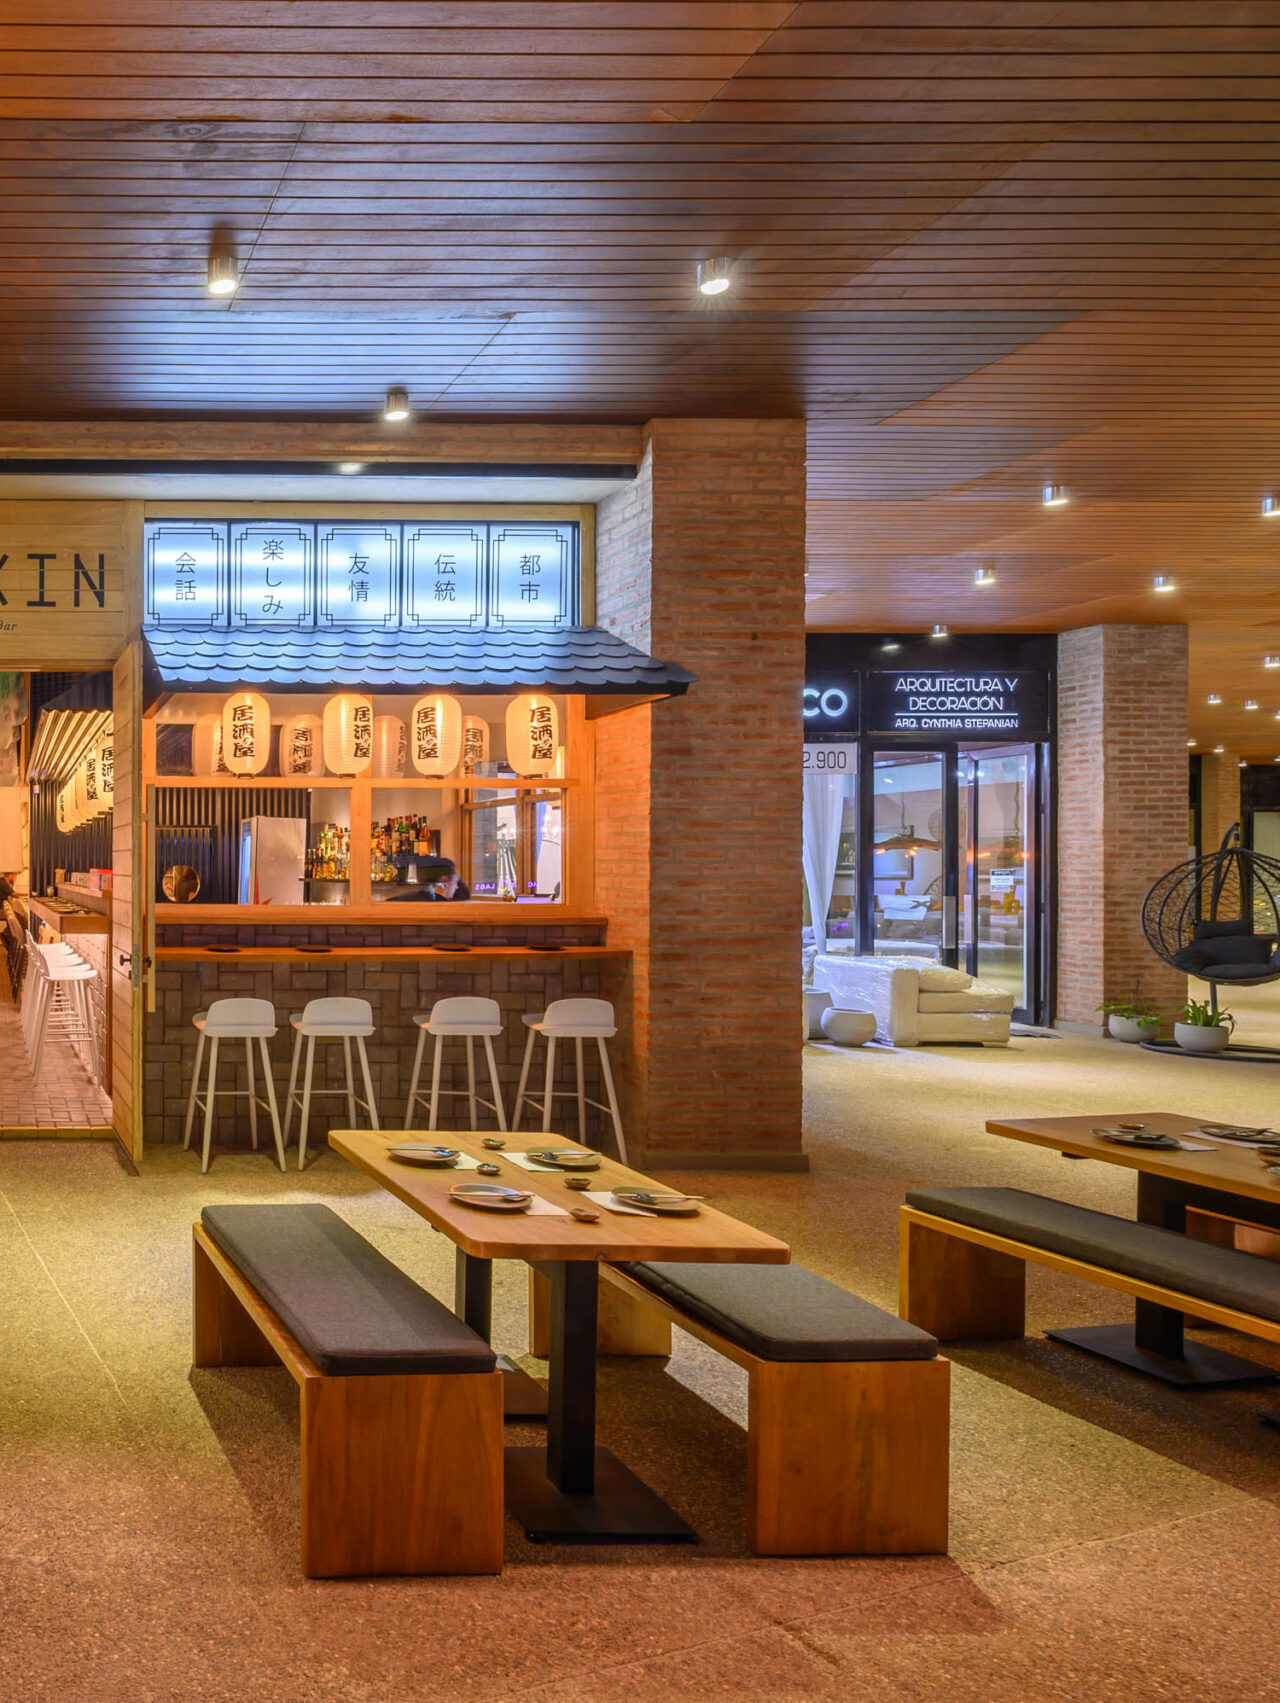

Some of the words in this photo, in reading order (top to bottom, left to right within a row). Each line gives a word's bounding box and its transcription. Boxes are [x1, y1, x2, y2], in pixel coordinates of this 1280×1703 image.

[175, 552, 197, 601] 会話
[262, 539, 284, 615] 楽しみ
[348, 553, 370, 602] 友情
[434, 554, 456, 602] 伝統
[519, 554, 541, 603] 都市
[895, 678, 1003, 692] ARQUITECTURA
[1005, 678, 1018, 692] Y
[909, 696, 1004, 711] DECORACIÓN
[895, 718, 919, 728] ARQ.
[922, 718, 963, 728] CYNTHIA
[965, 718, 1018, 728] STEPANIAN
